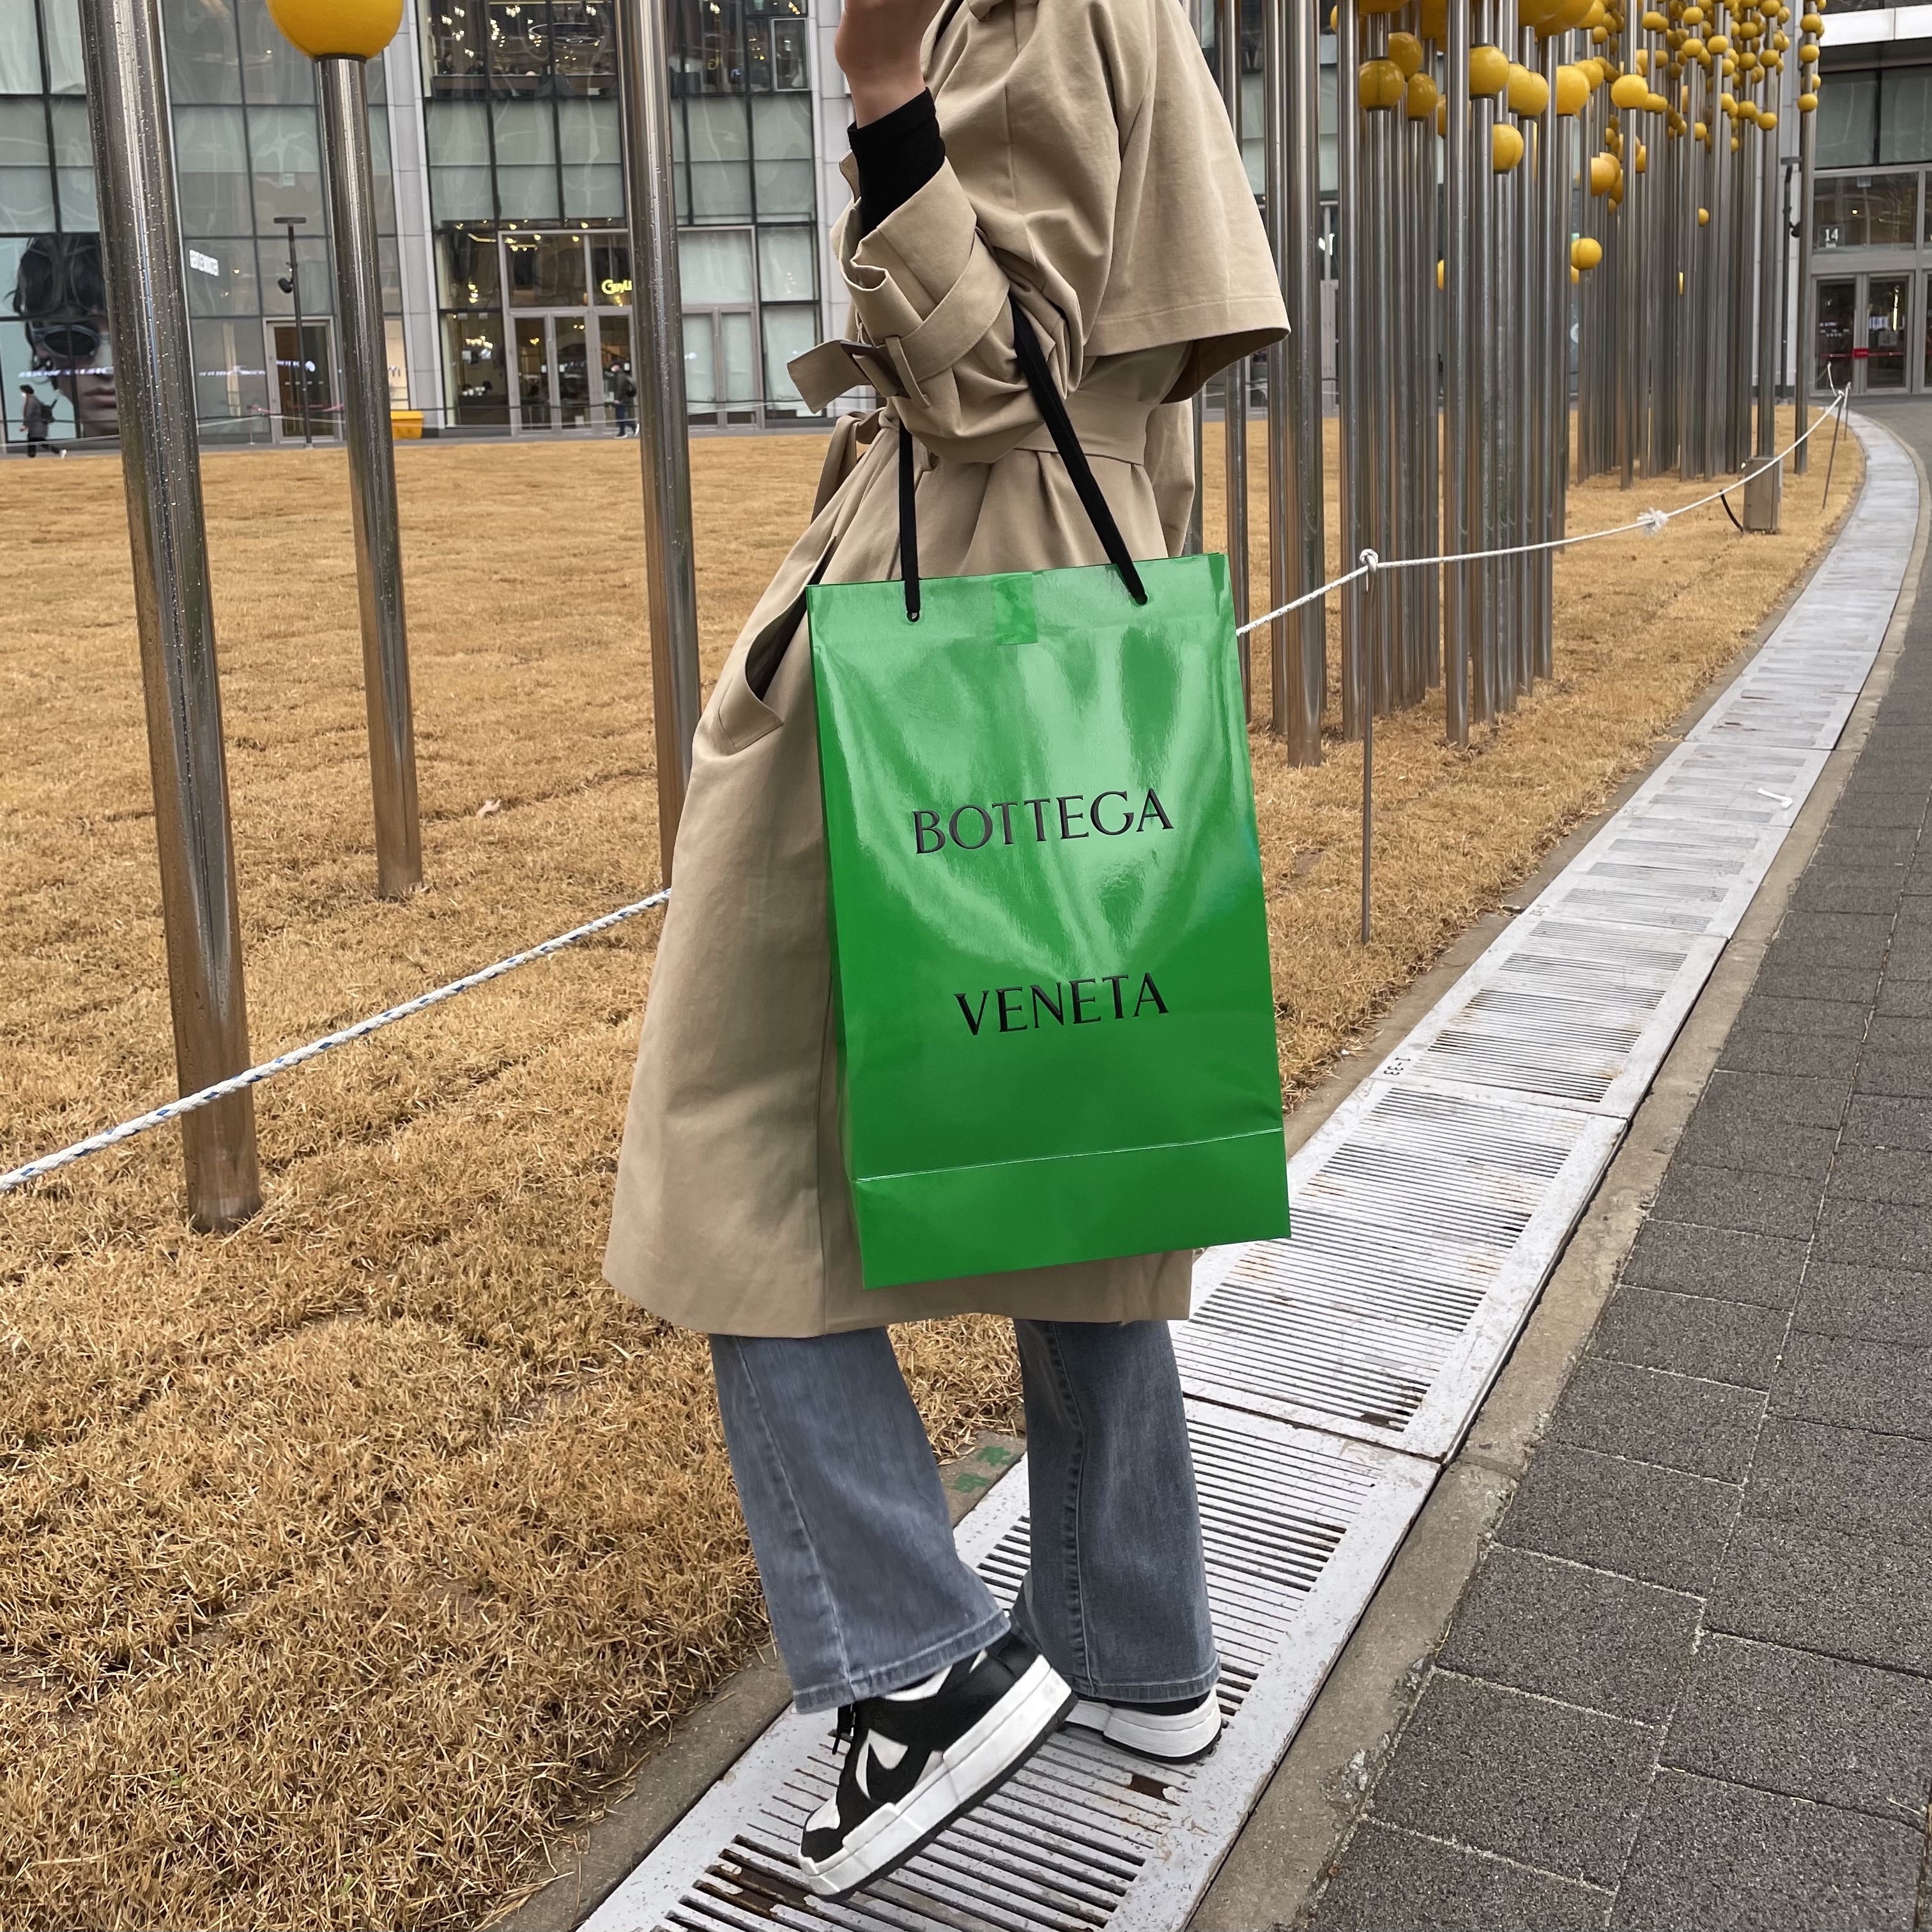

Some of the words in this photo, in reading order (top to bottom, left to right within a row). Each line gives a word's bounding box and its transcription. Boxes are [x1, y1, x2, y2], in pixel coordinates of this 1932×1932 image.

[1825, 228, 1839, 242] 14
[912, 788, 1174, 854] BOTTEGA
[954, 972, 1169, 1036] VENETA
